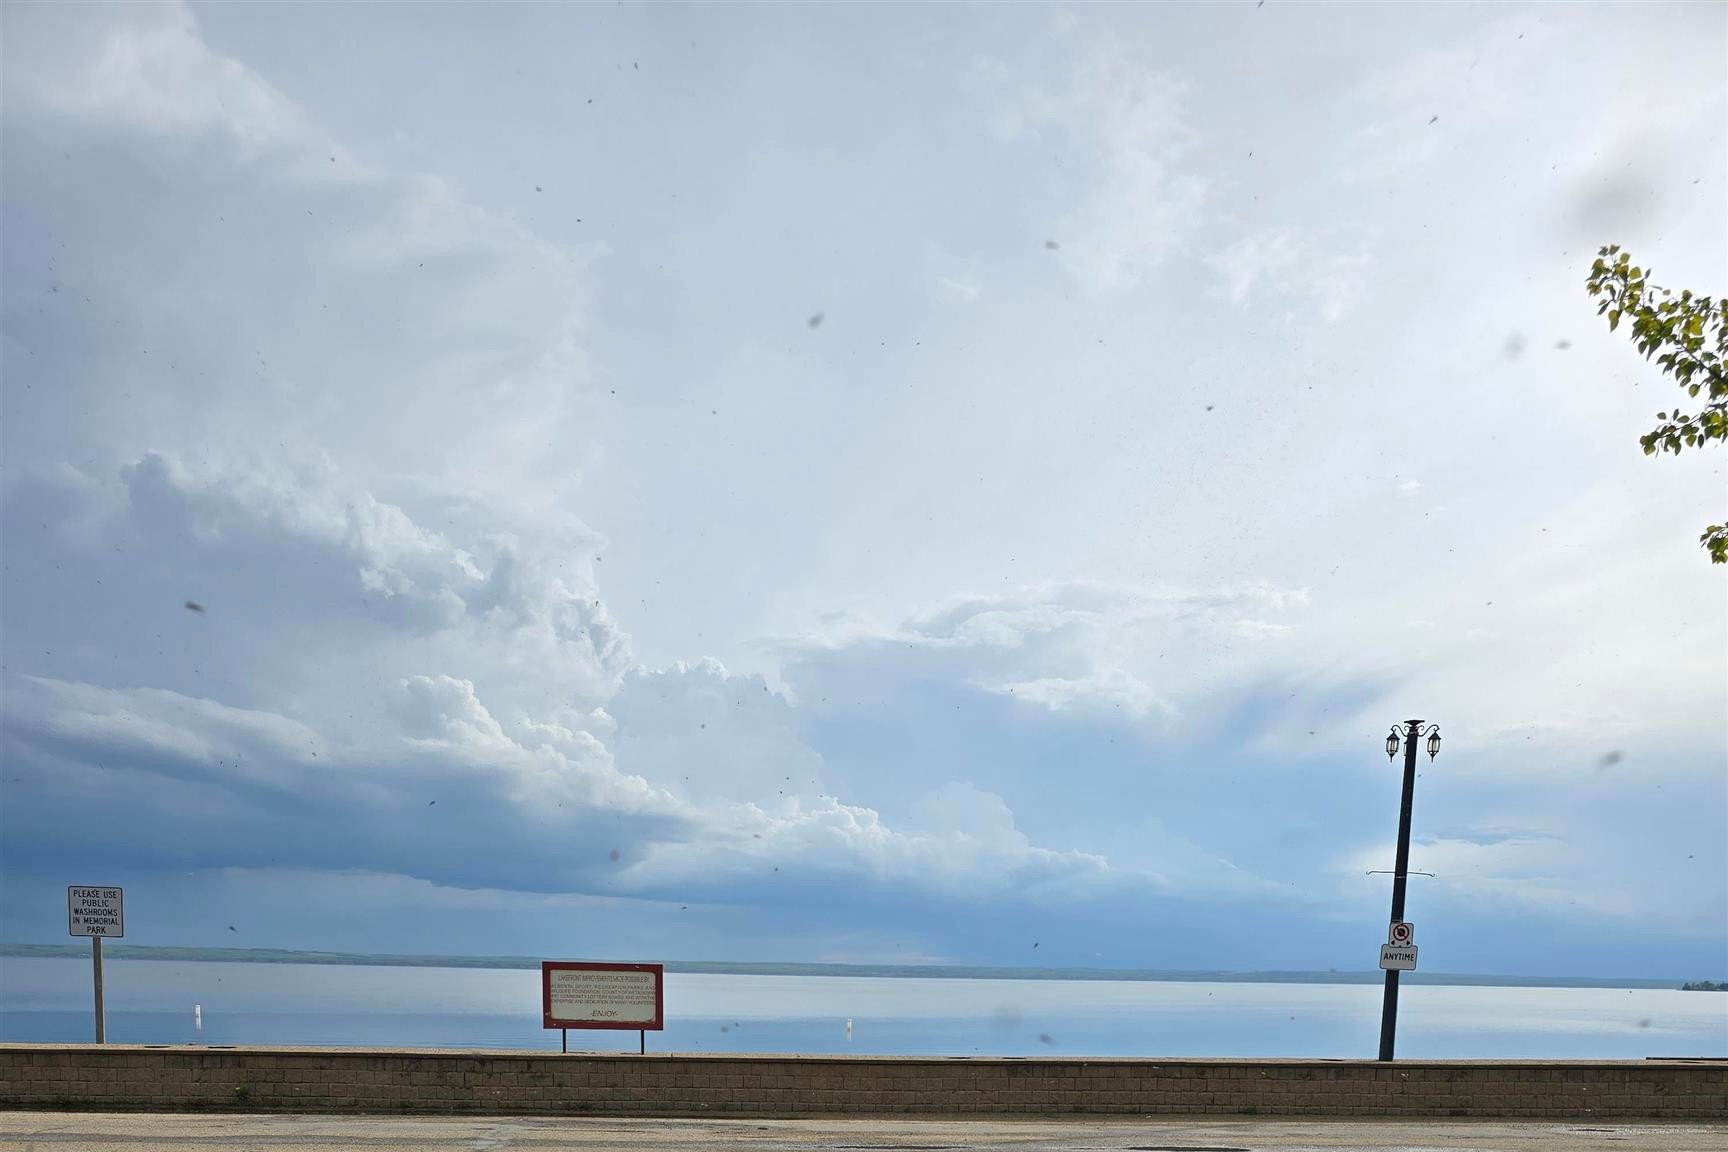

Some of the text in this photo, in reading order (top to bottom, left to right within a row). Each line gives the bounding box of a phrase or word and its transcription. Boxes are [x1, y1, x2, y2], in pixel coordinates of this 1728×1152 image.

[74, 890, 116, 898] PLEASE USE
[74, 908, 117, 916] WASHROOMS
[84, 917, 119, 925] MEMORIAL
[87, 926, 106, 934] PARK
[1384, 953, 1414, 961] ANYTIME
